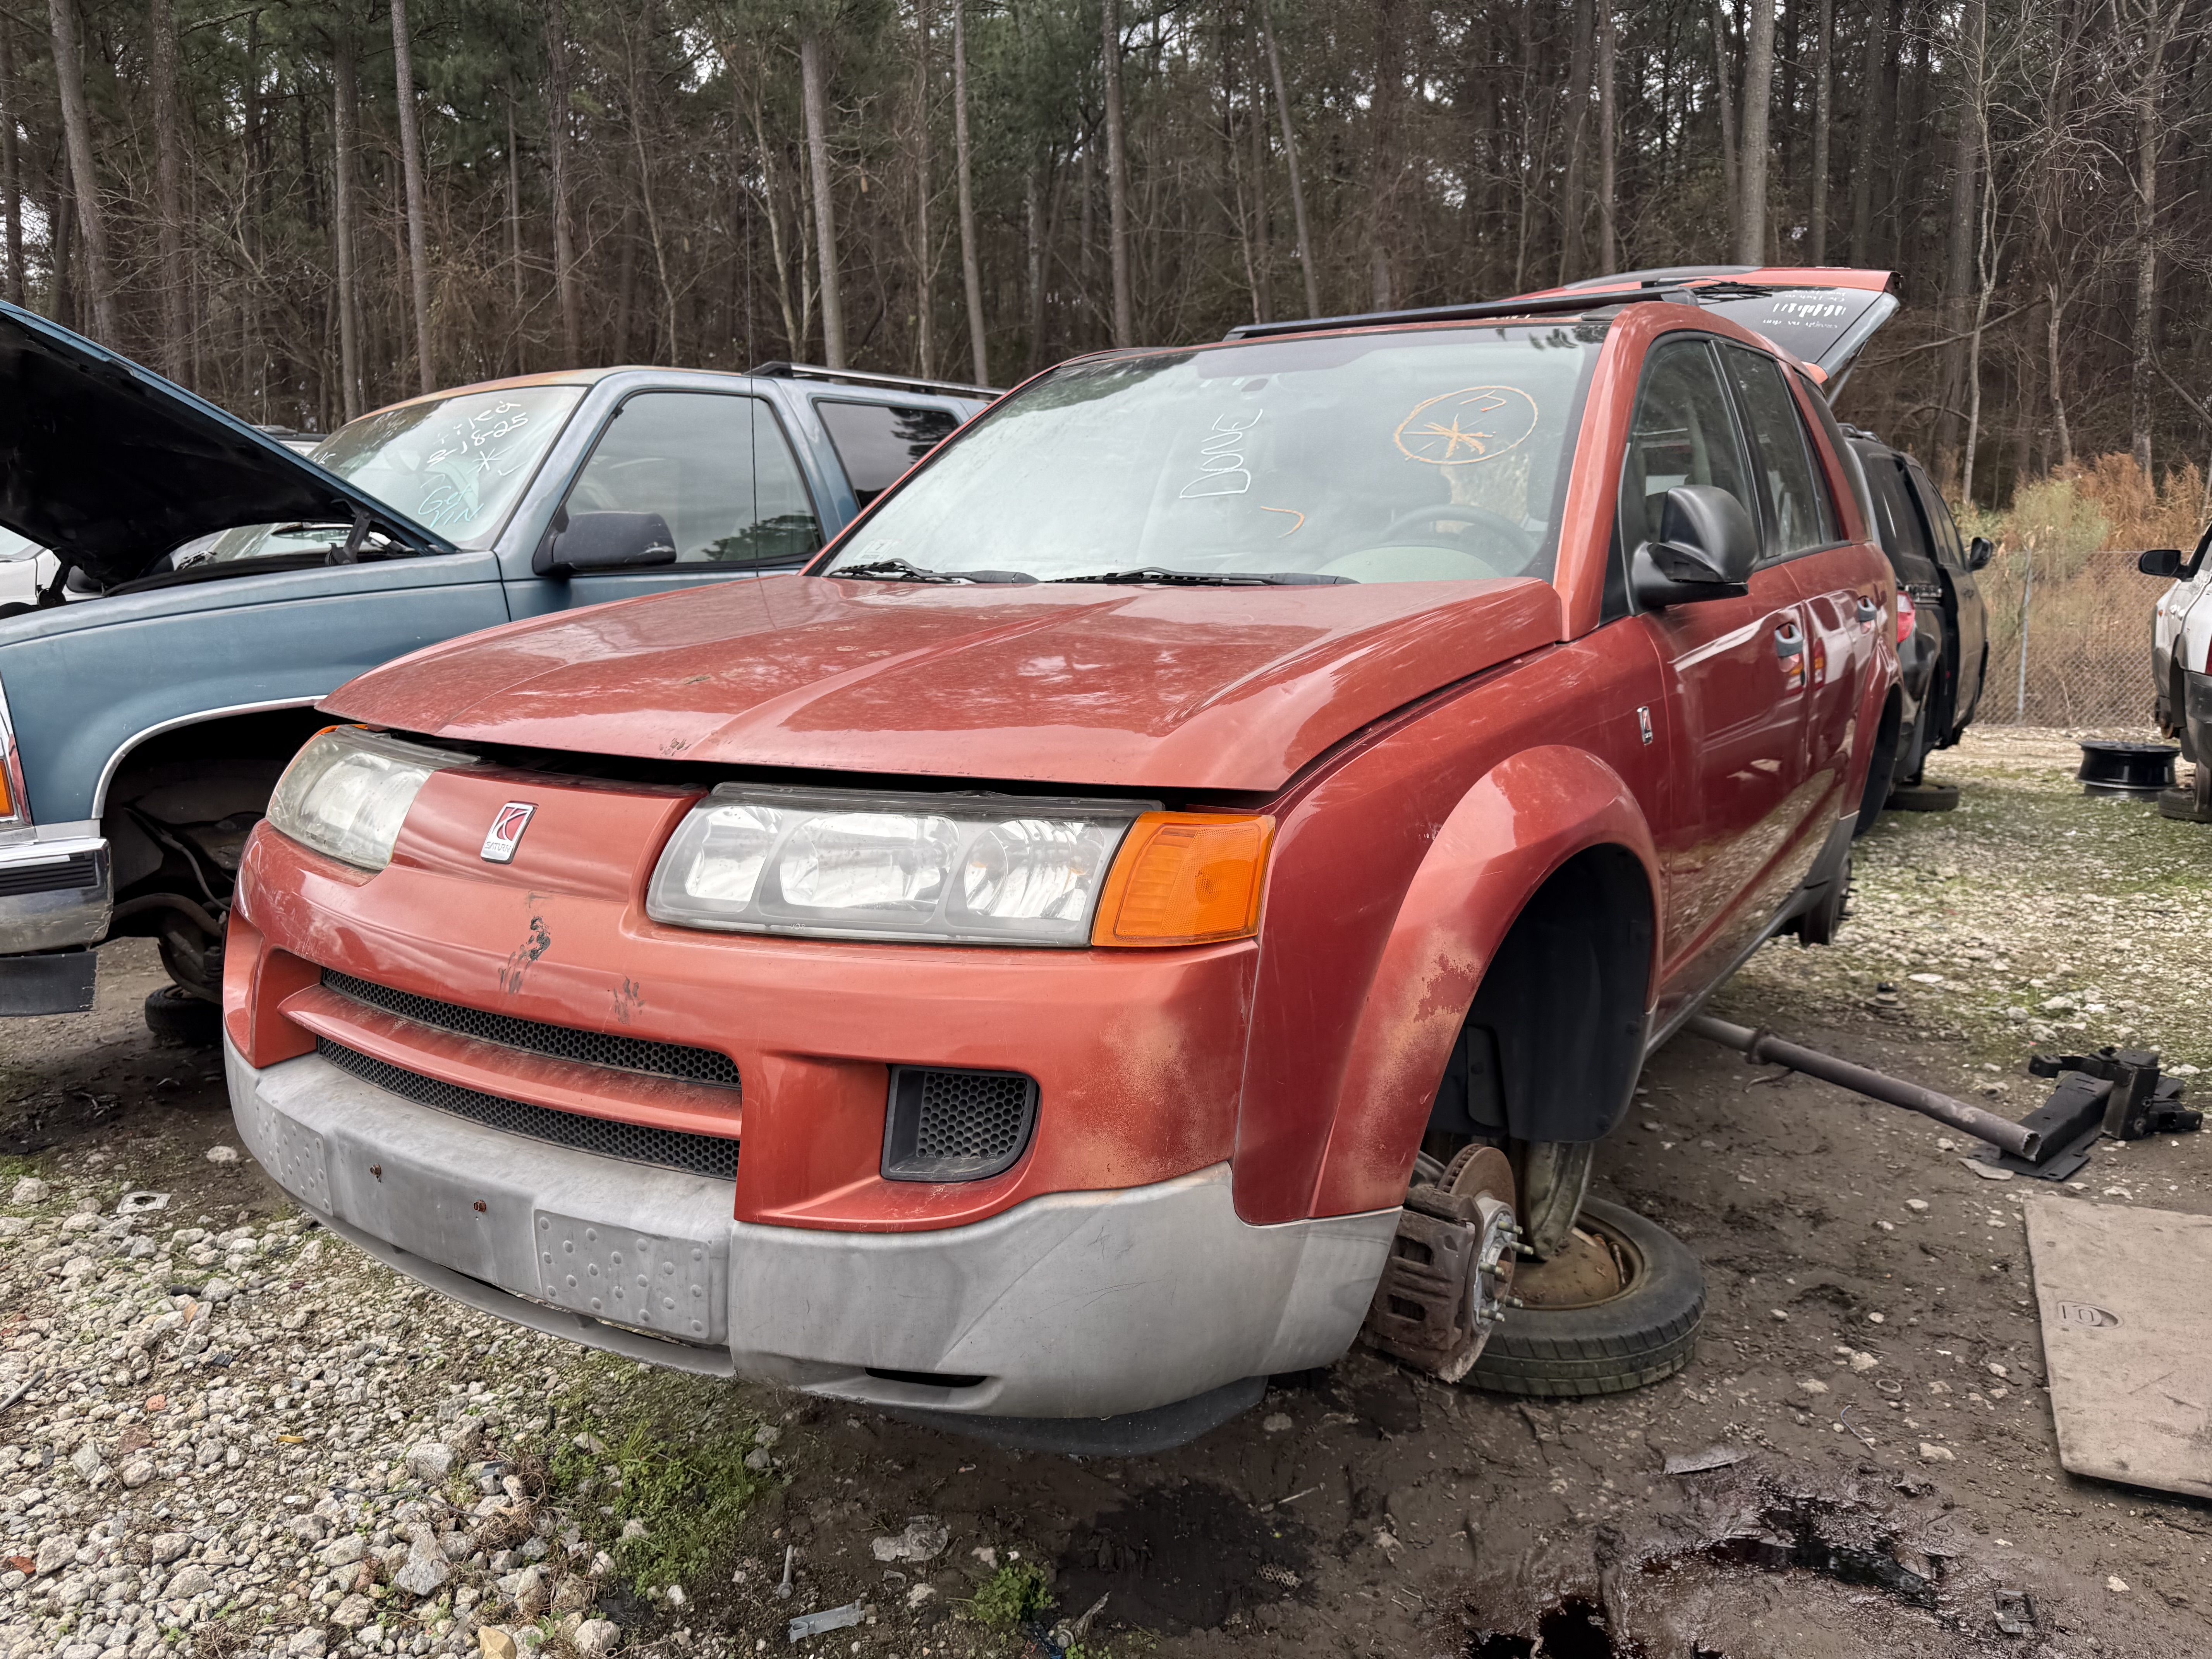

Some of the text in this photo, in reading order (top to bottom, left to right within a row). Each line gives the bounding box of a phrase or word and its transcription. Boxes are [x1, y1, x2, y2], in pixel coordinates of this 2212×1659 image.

[1179, 409, 1263, 499] DONE
[418, 483, 472, 515] Get
[429, 503, 484, 529] VIN
[485, 842, 511, 853] SATURN
